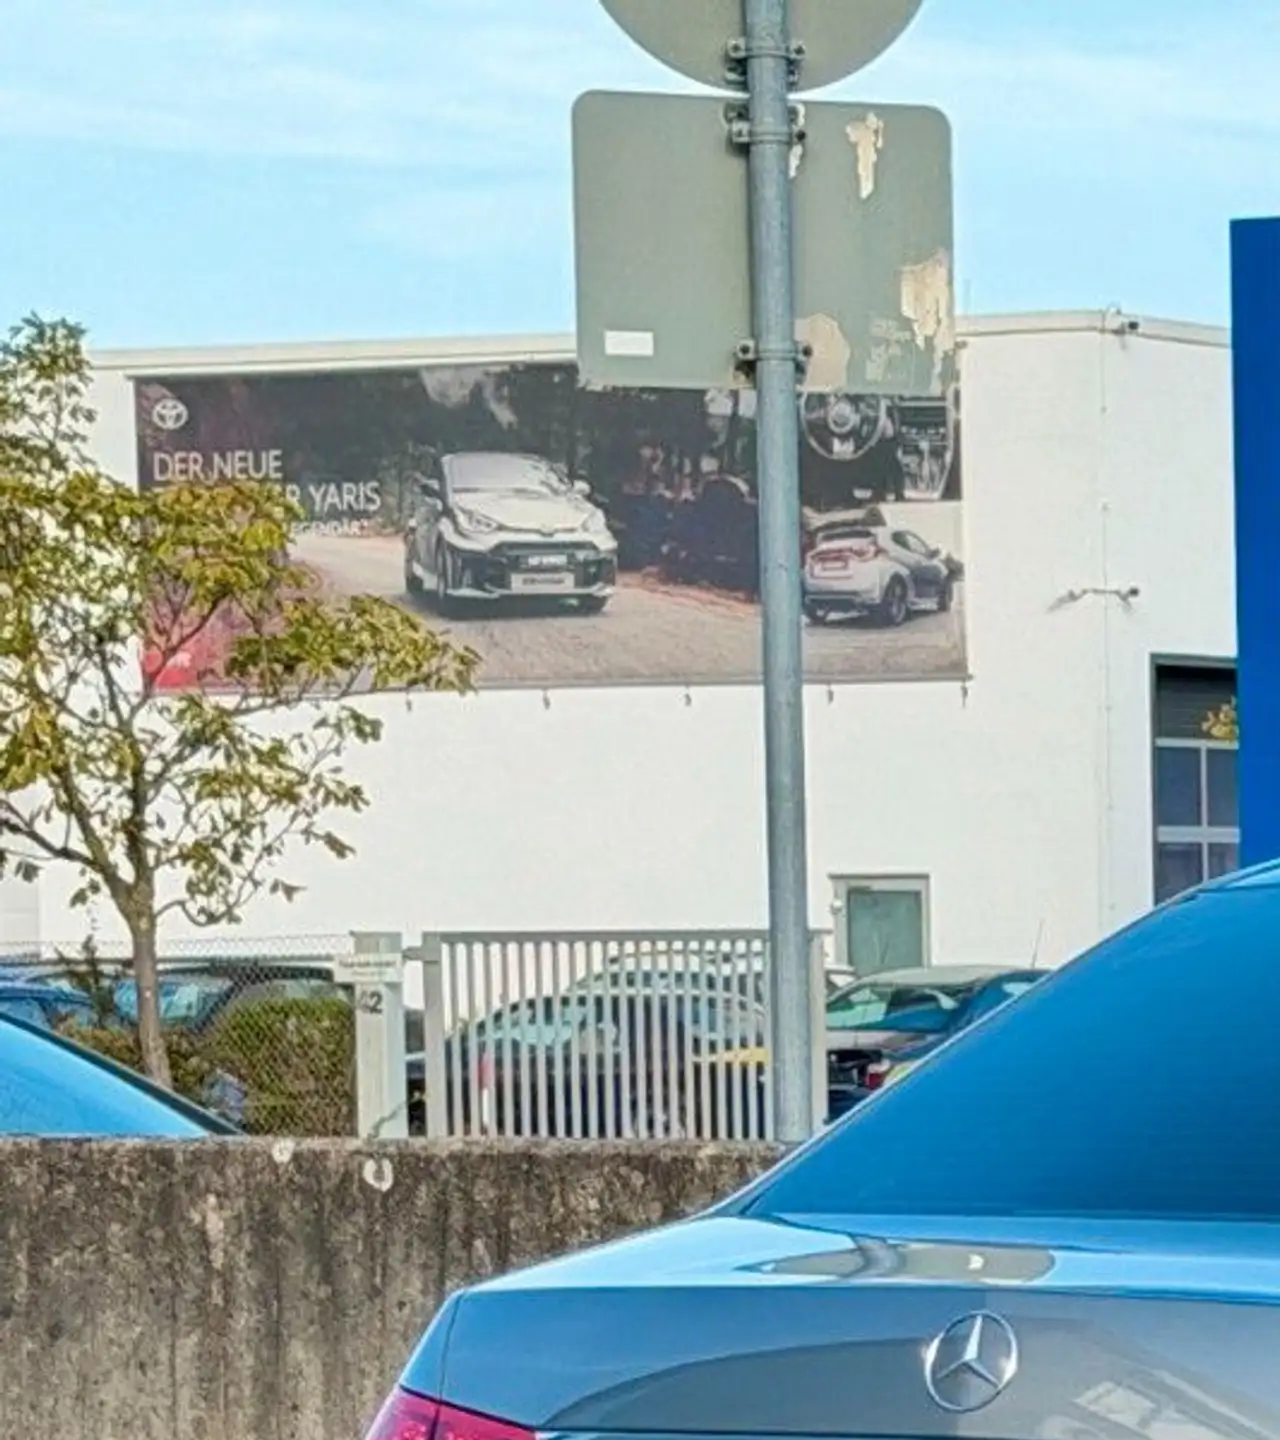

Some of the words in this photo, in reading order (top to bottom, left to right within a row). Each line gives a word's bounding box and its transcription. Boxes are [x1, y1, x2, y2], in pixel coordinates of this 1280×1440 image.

[153, 452, 204, 482] DER
[212, 450, 283, 480] NEUE
[308, 481, 382, 512] YARIS
